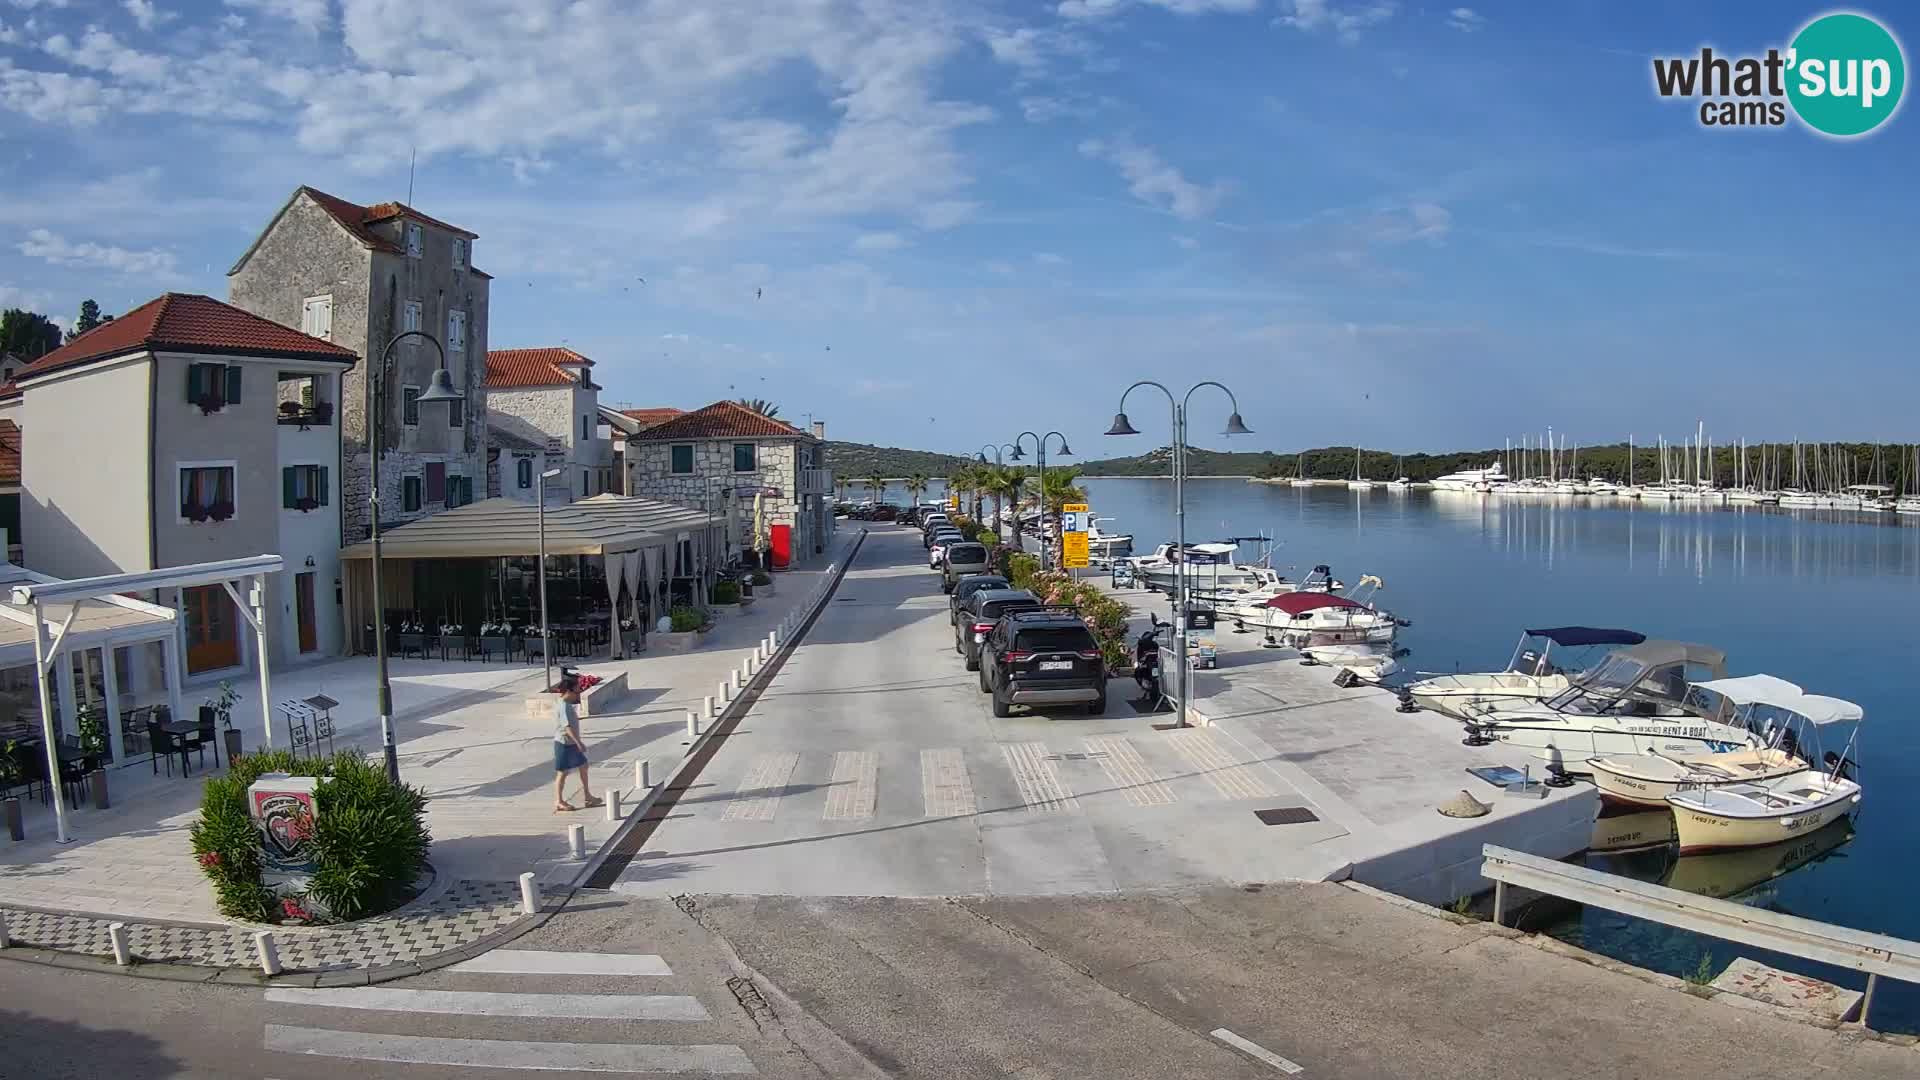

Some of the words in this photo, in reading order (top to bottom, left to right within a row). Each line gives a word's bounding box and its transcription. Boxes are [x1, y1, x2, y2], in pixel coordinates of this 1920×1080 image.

[1065, 514, 1076, 530] P
[1663, 726, 1681, 736] RENT
[1682, 727, 1688, 735] A
[1689, 727, 1707, 737] BOAT
